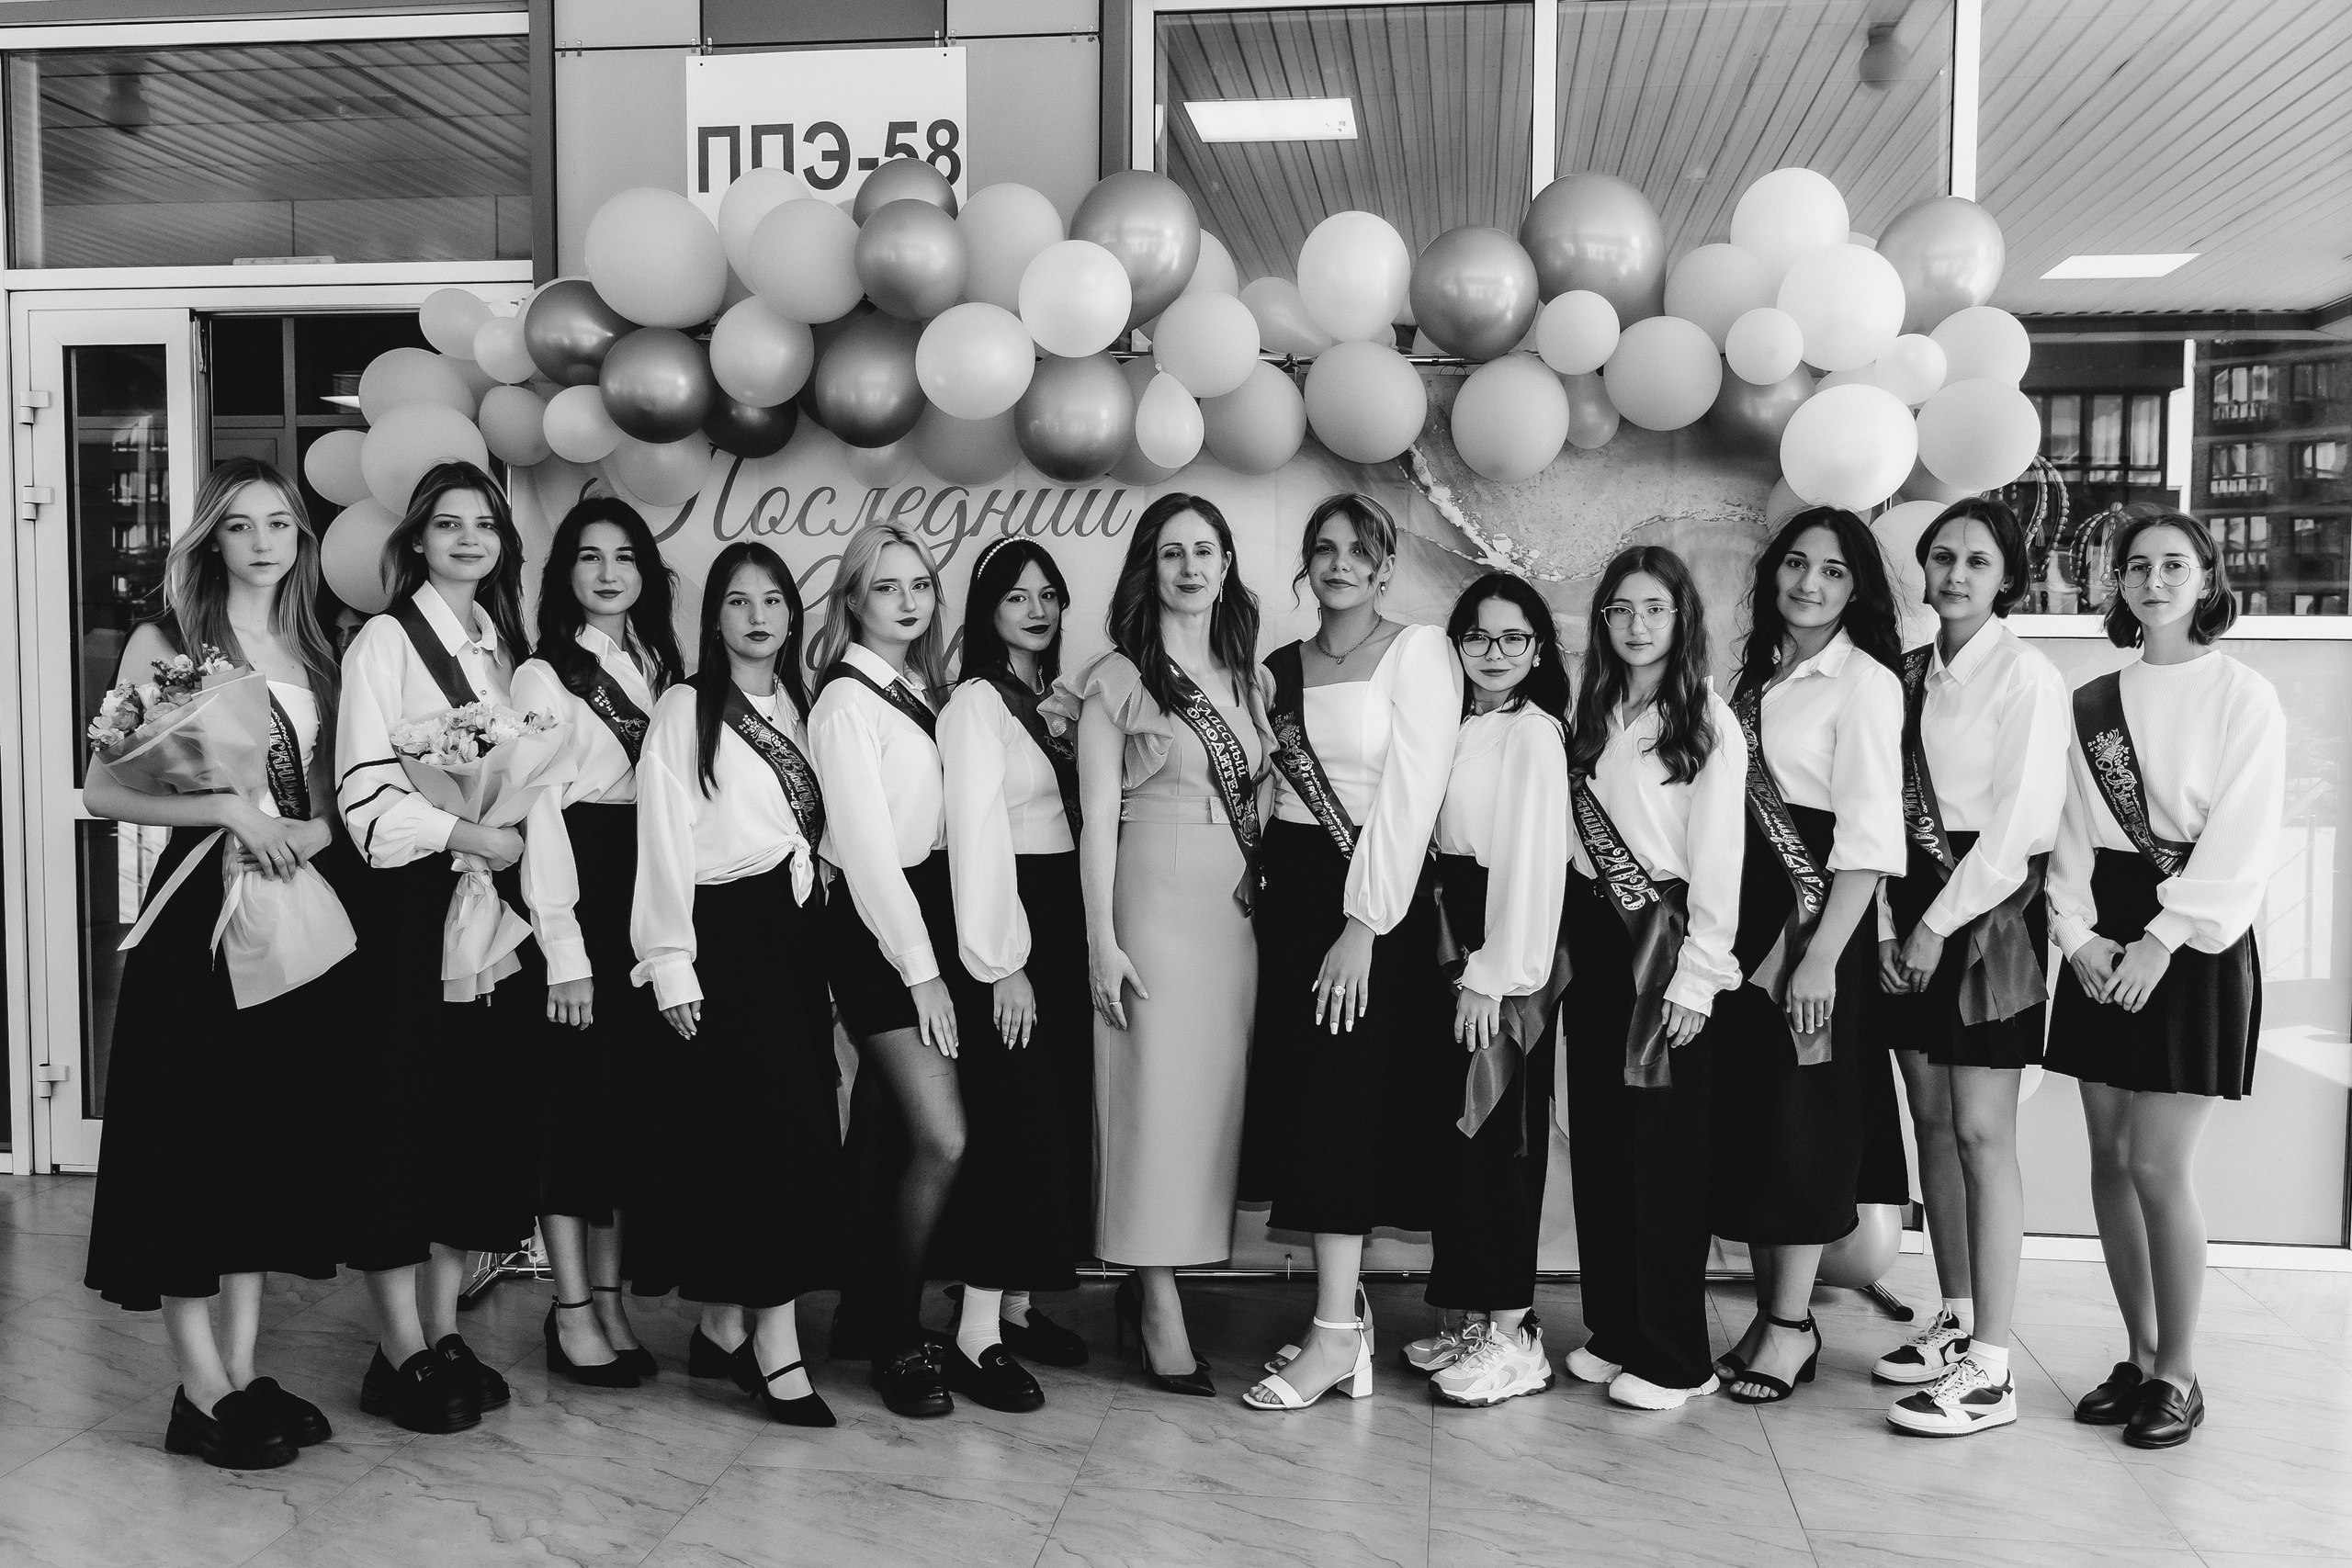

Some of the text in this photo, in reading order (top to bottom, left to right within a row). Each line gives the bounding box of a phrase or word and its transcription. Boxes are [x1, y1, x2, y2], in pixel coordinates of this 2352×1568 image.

[1186, 706, 1243, 818] ОВОДИТЕЛЬ
[1190, 689, 1250, 777] Классный
[1595, 847, 1660, 910] 2025
